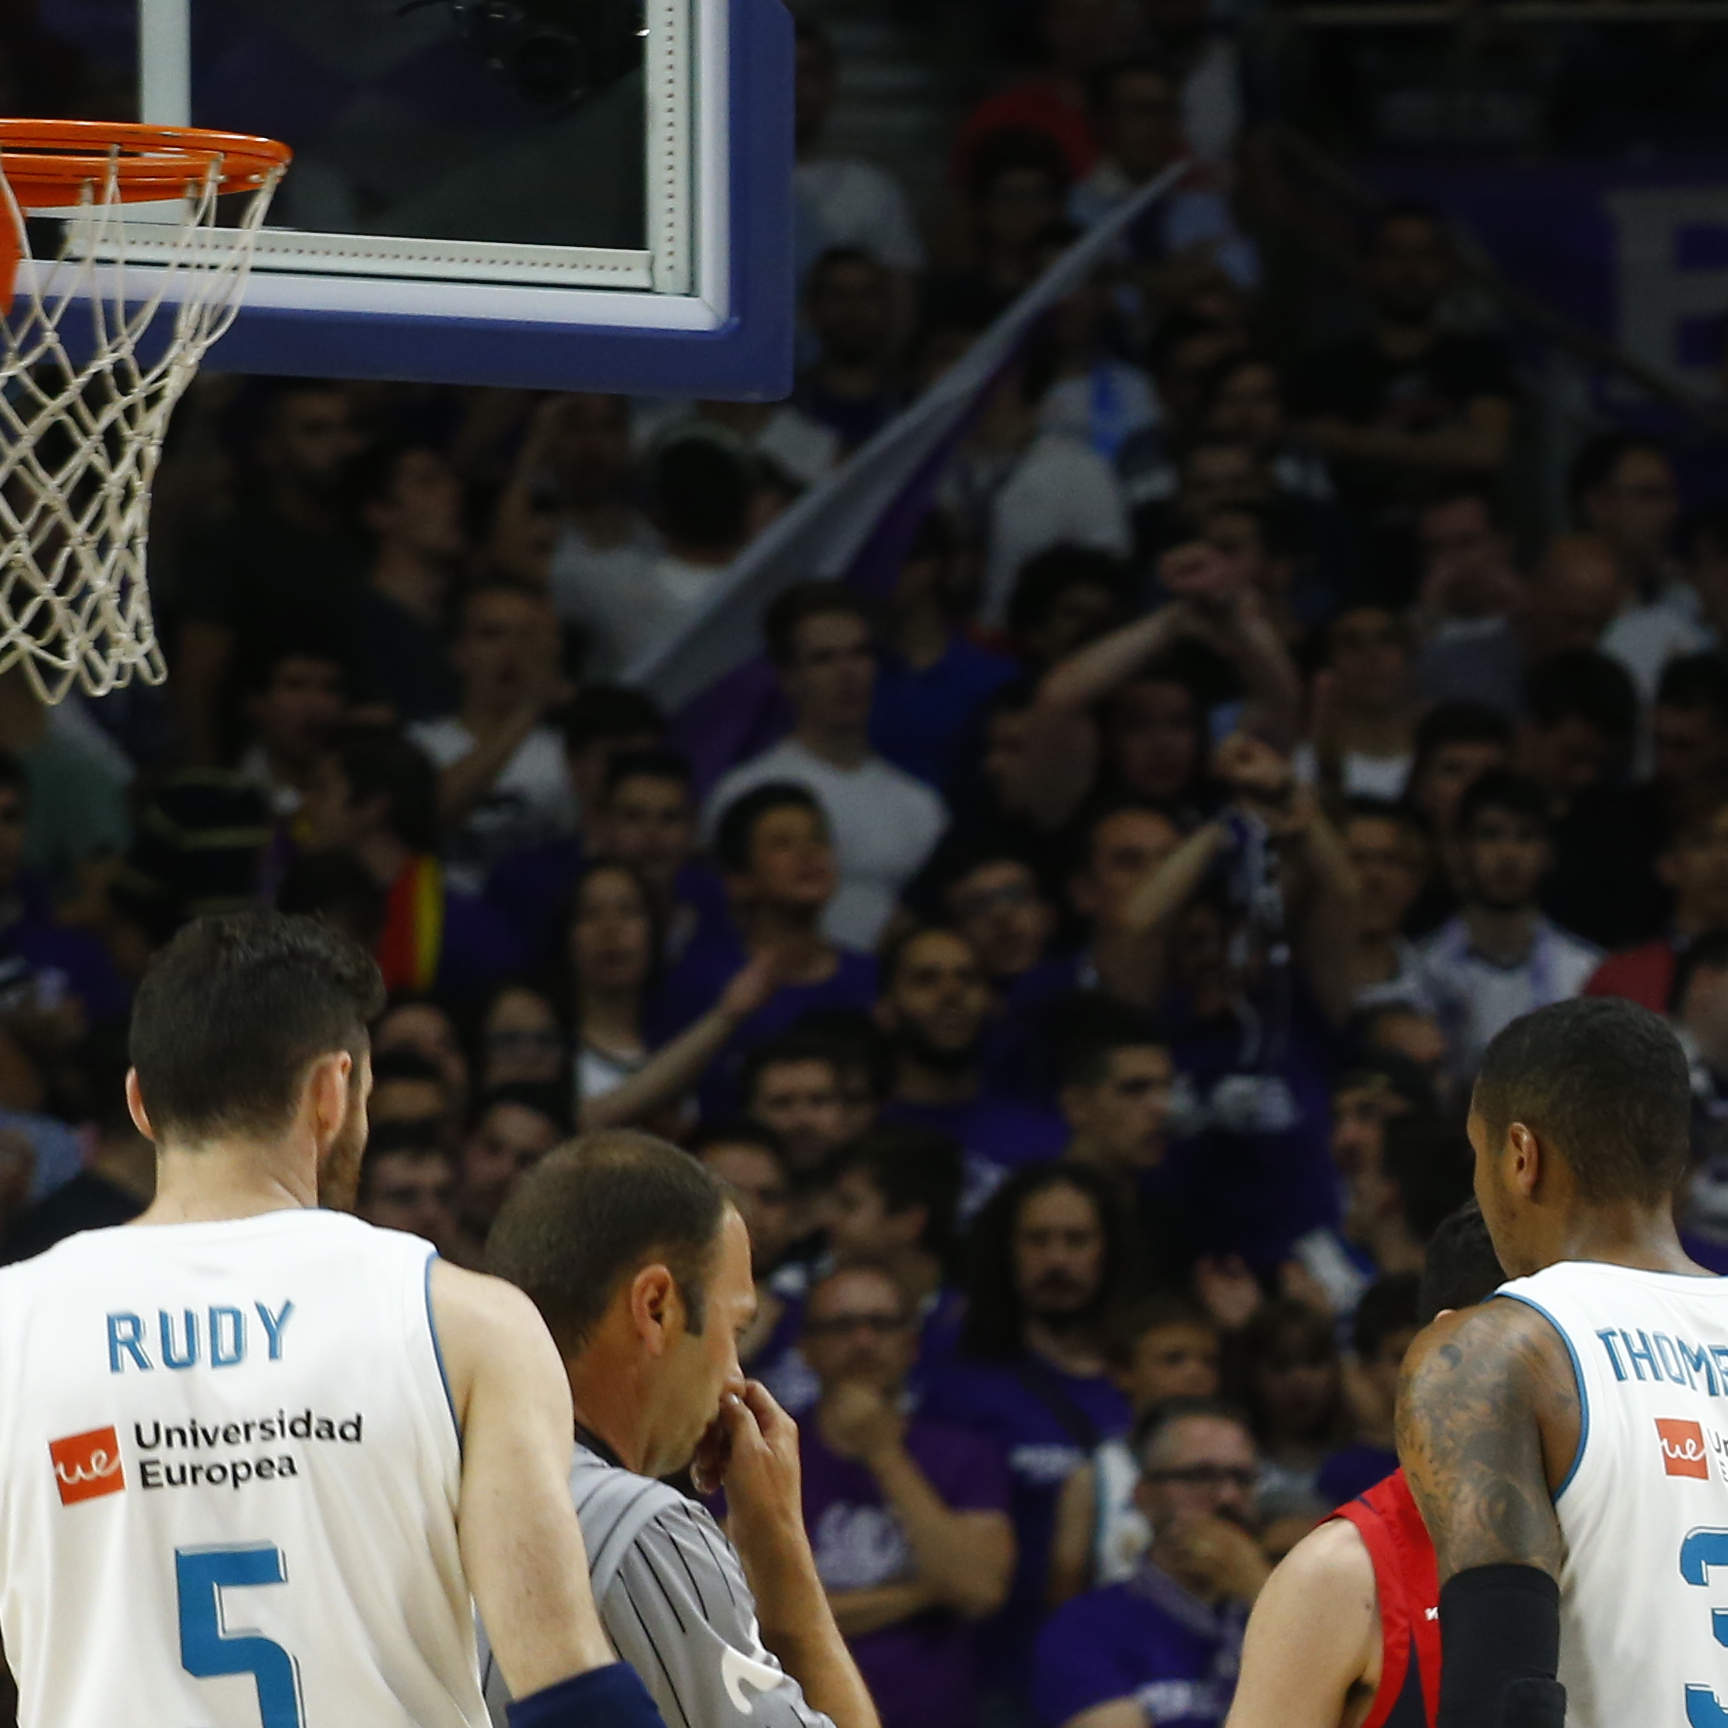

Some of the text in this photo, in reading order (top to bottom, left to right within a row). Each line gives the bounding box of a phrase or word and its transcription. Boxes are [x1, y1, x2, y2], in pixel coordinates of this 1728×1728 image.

[107, 1300, 295, 1374] RUDY
[134, 1409, 363, 1450] Universidad
[140, 1455, 299, 1490] Europea
